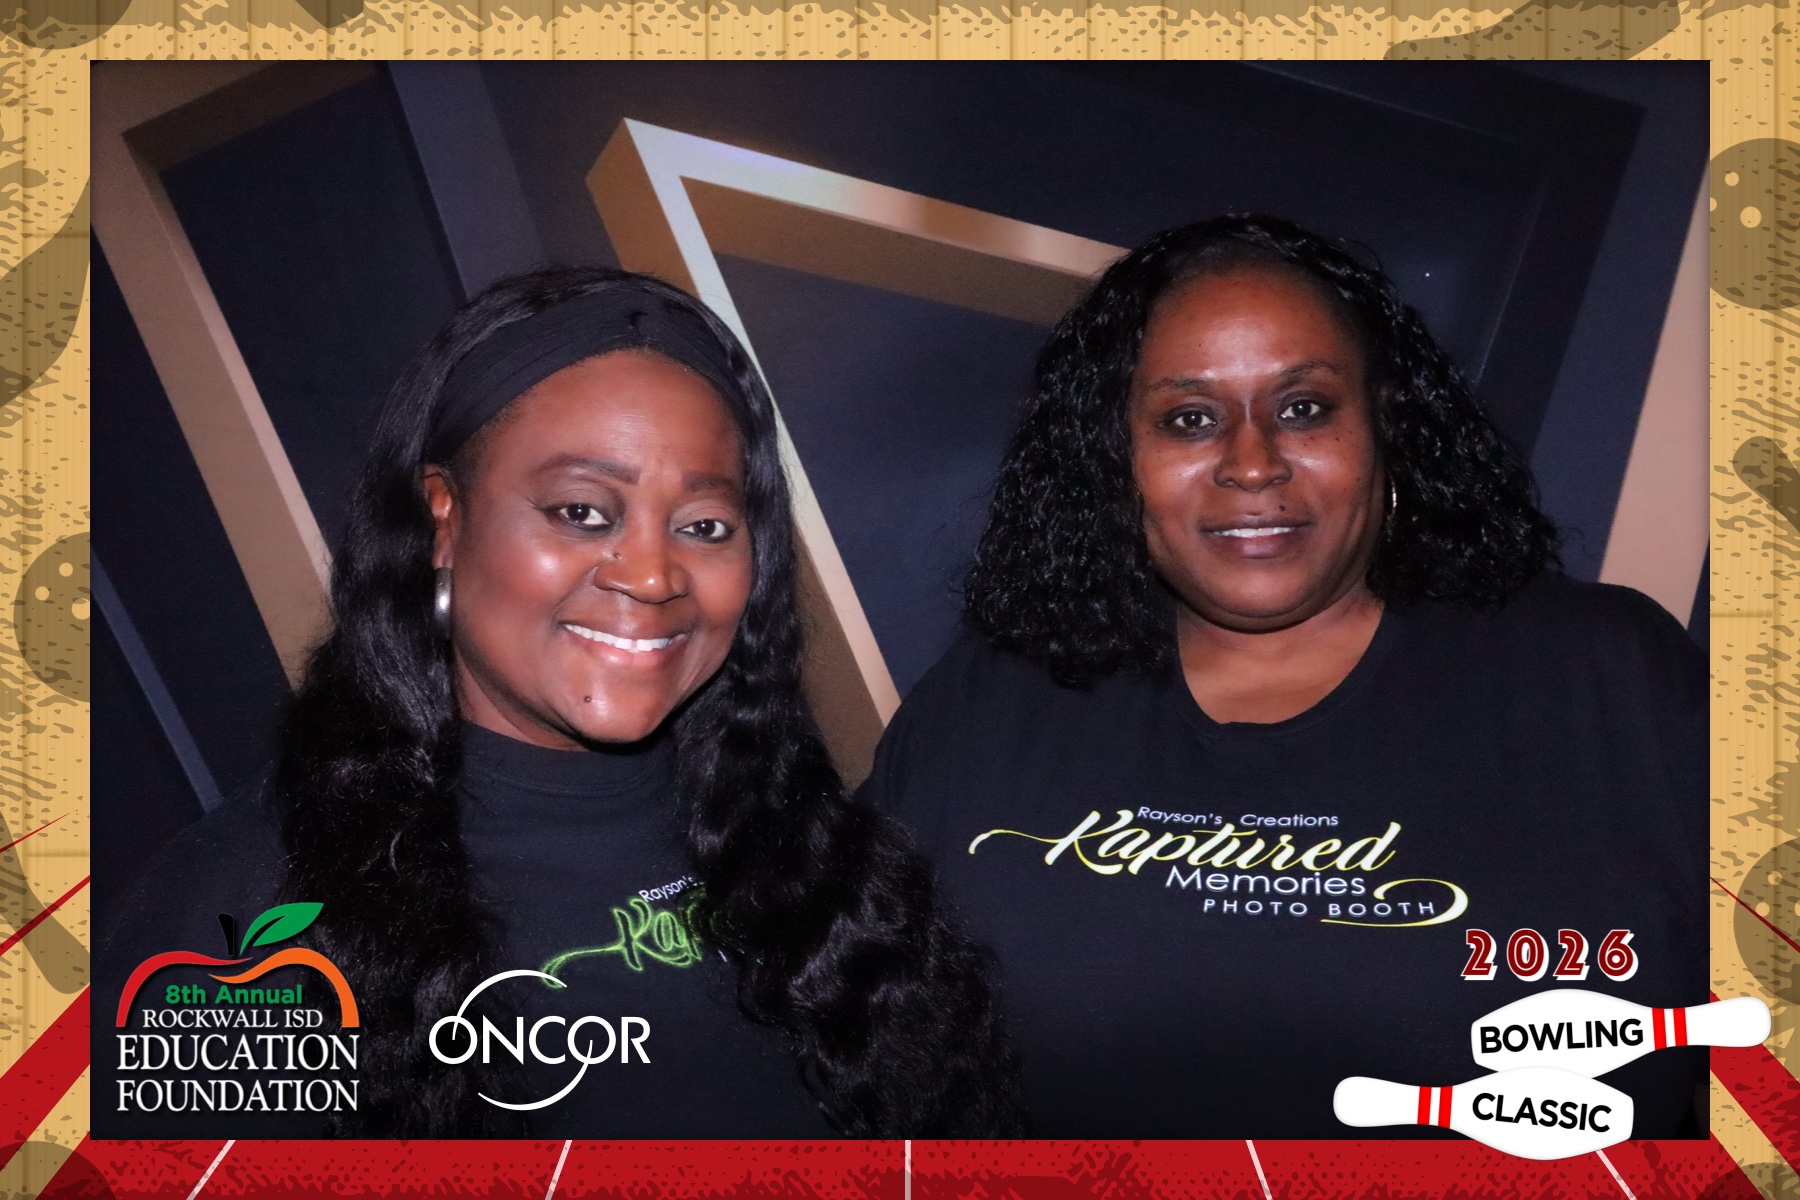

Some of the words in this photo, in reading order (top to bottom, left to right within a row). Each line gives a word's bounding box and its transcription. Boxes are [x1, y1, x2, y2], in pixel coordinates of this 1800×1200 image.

[1137, 806, 1223, 826] Rayson's
[1240, 813, 1339, 827] Creations
[969, 808, 1402, 876] Kaptured
[1165, 864, 1367, 897] Memories
[1203, 898, 1308, 917] PHOTO
[1328, 901, 1435, 918] BOOTH
